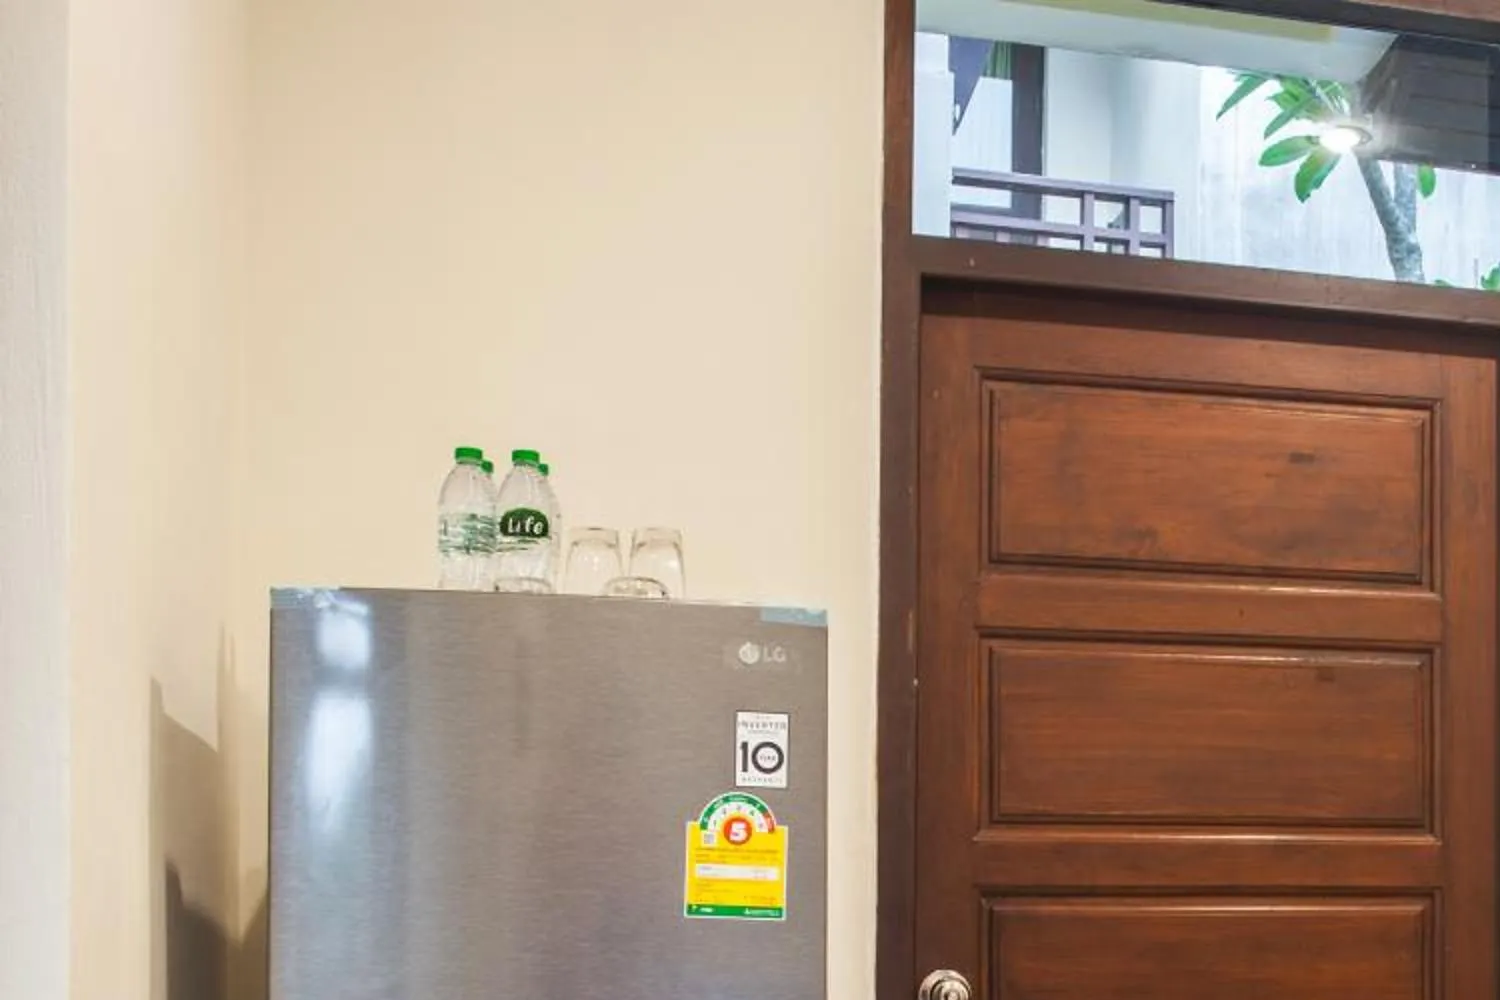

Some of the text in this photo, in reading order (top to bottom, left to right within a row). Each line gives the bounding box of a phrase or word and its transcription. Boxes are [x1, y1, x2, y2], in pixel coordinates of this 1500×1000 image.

[508, 515, 544, 534] Life
[763, 646, 787, 663] LG
[740, 741, 784, 774] 10
[729, 821, 748, 842] 5
